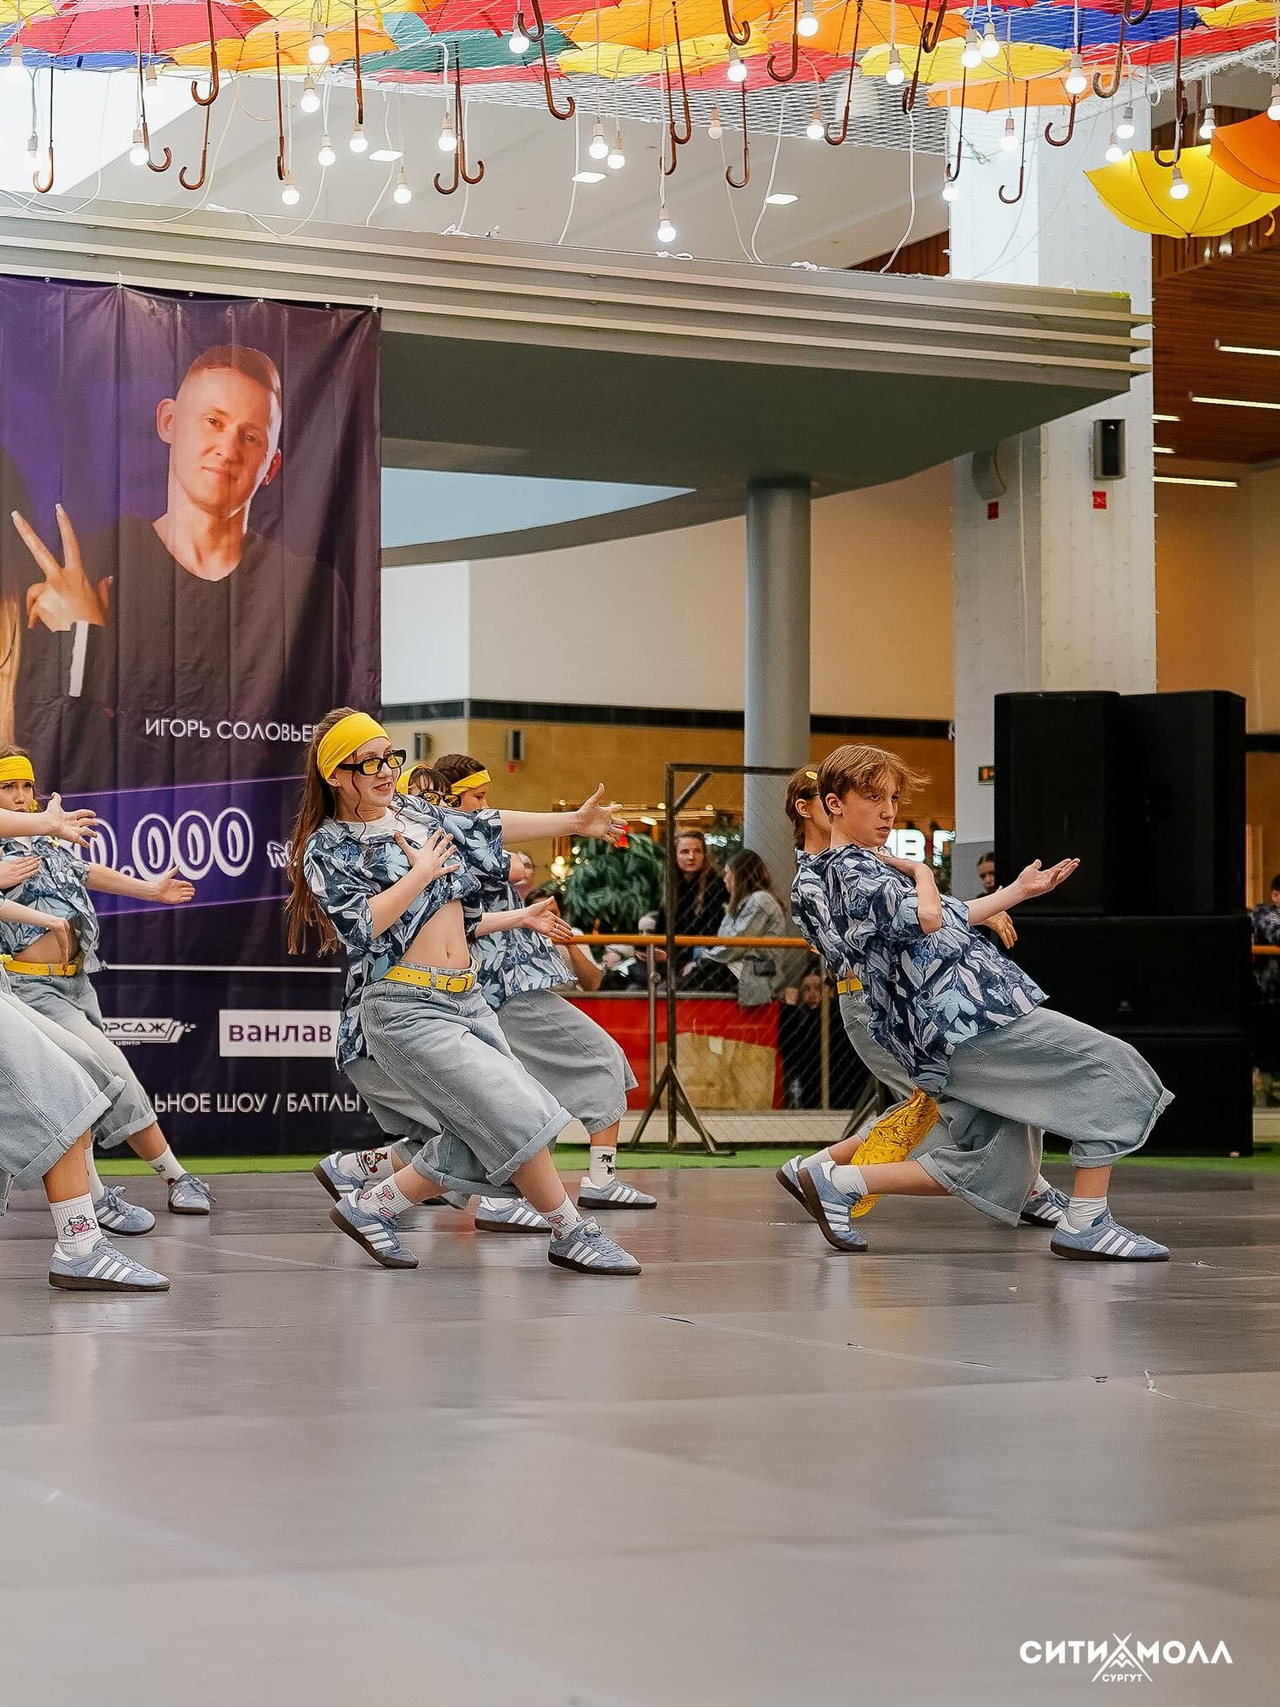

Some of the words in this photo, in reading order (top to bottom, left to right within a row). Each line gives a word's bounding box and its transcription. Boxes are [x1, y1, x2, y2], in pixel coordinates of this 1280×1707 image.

[145, 718, 211, 738] ИГОРЬ
[228, 1023, 332, 1043] ванлав
[217, 1093, 268, 1114] ШОУ
[287, 1093, 360, 1113] БАТТЛЫ
